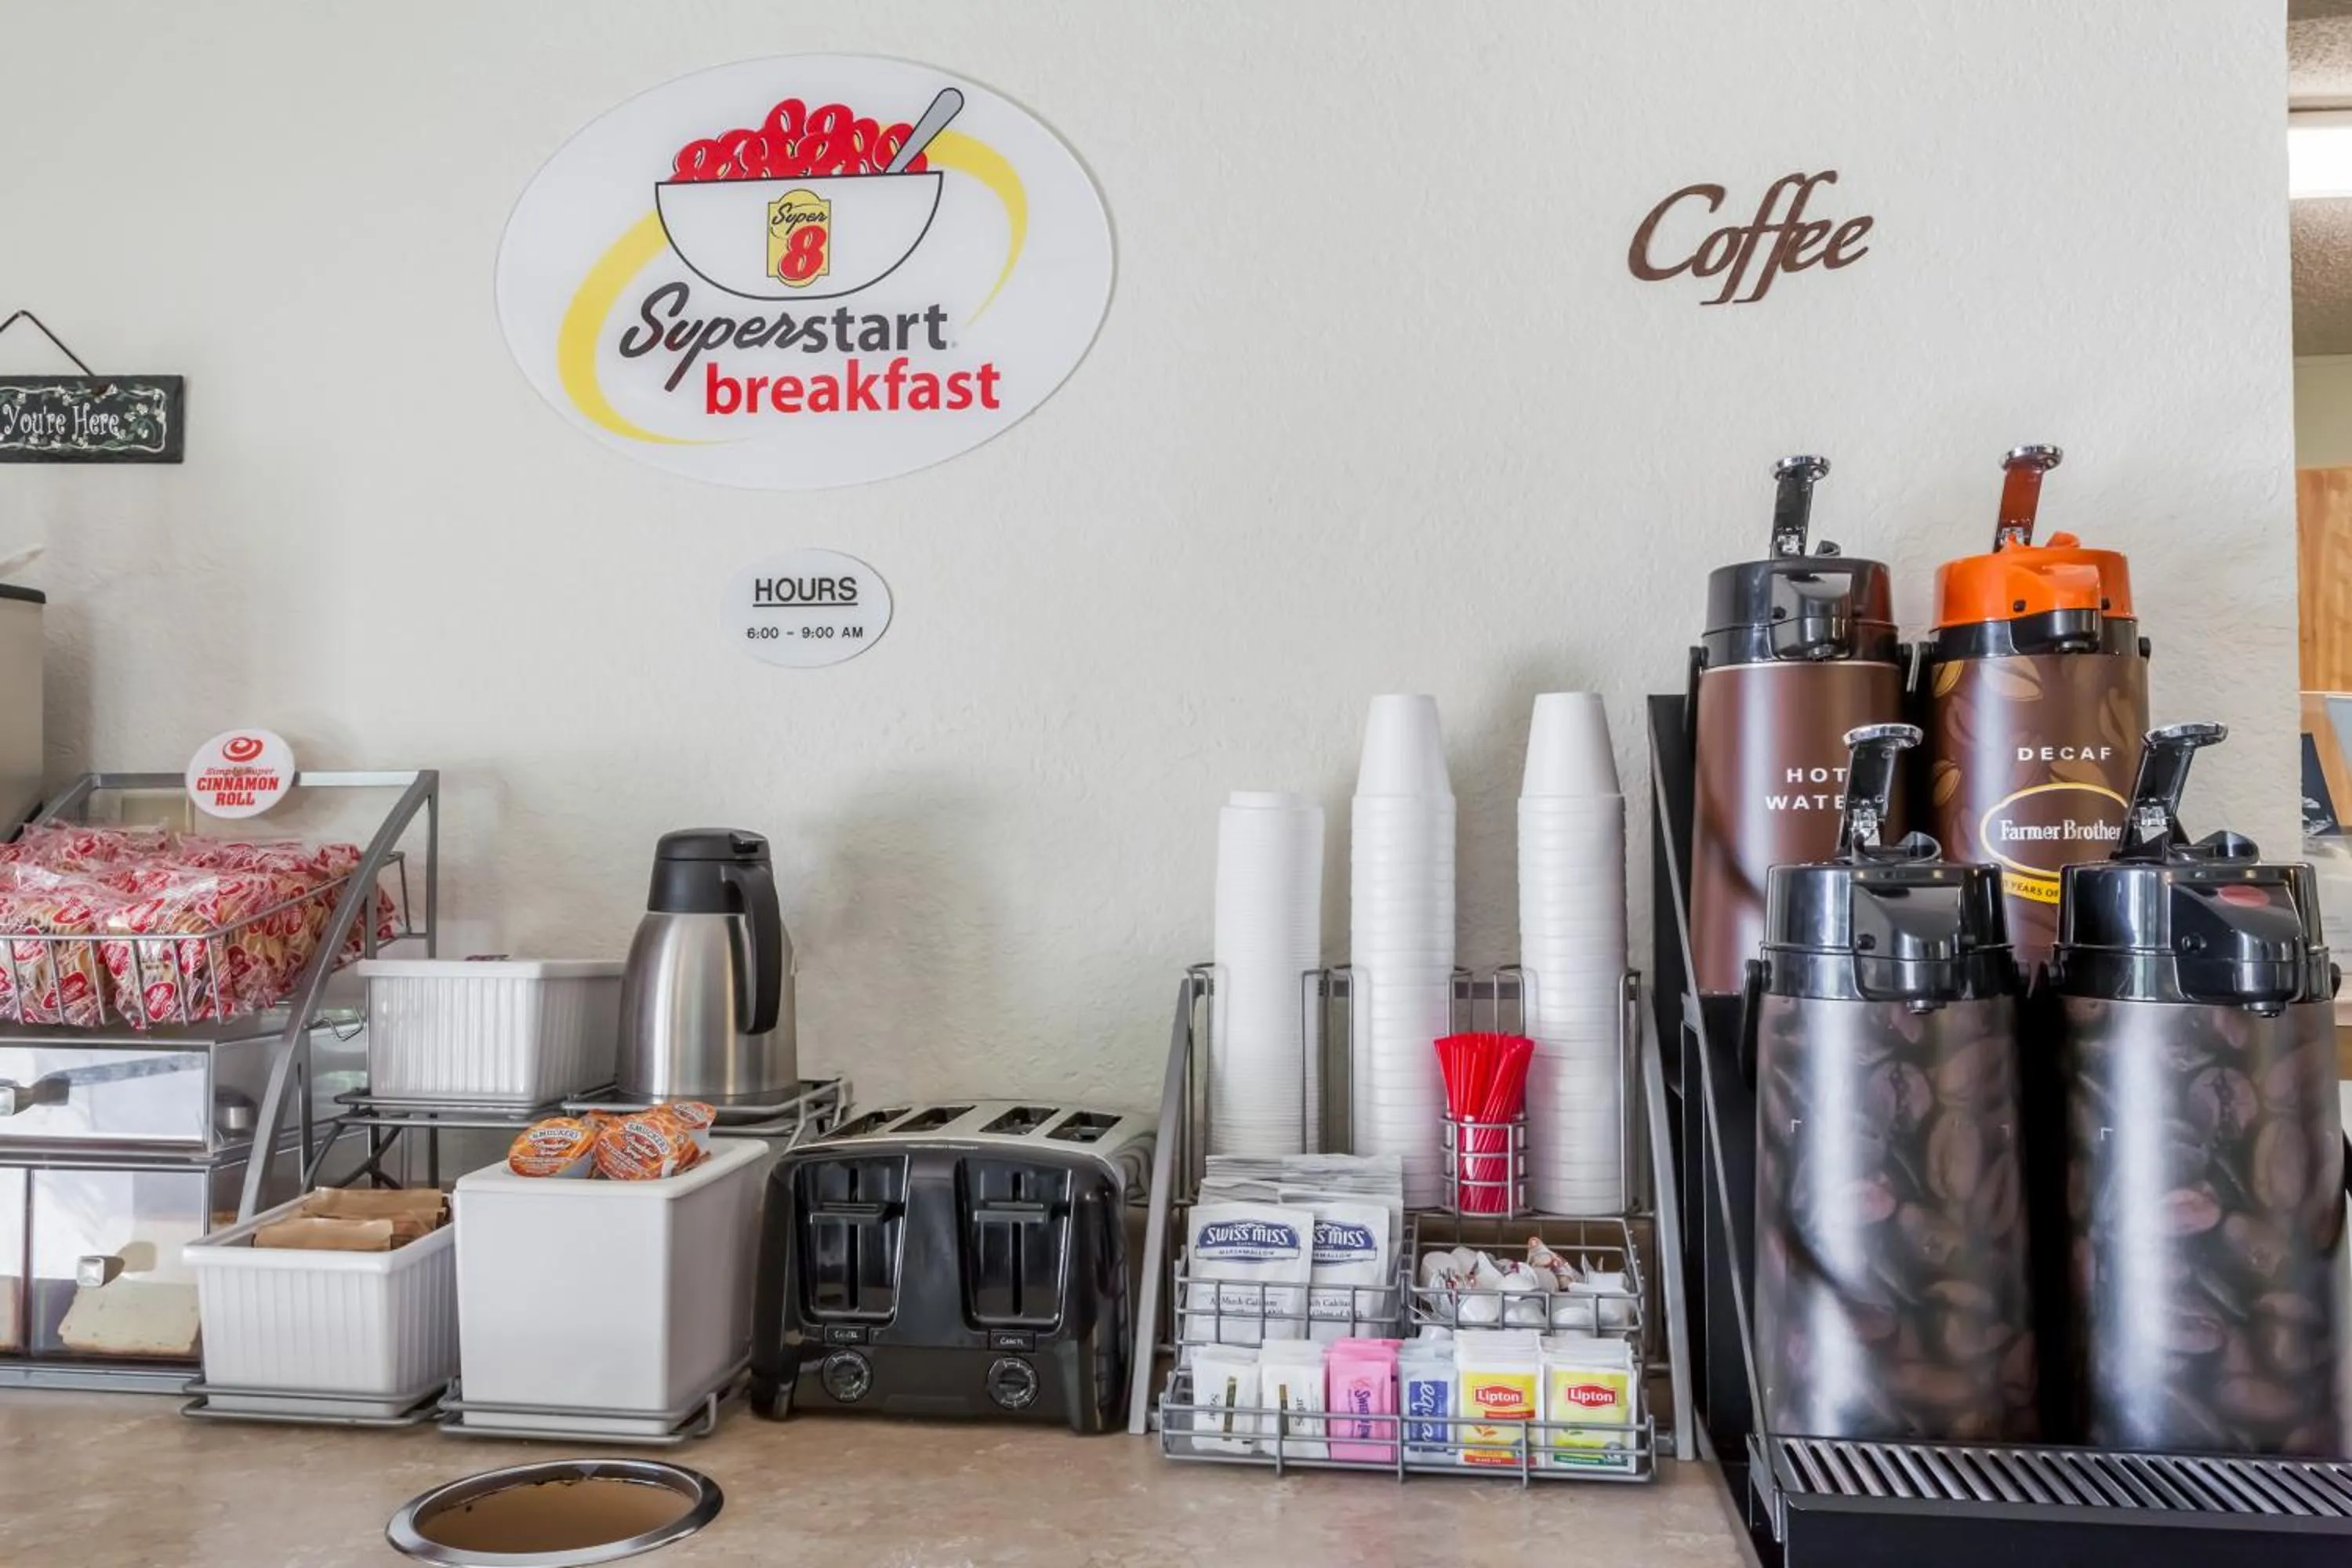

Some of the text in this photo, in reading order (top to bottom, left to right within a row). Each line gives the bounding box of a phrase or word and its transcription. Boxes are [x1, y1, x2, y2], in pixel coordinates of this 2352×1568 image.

[771, 202, 829, 234] Super
[1628, 169, 1874, 306] Coffee
[777, 224, 828, 281] 8
[619, 281, 949, 393] Superstart
[706, 357, 1001, 415] breakfast
[2, 402, 120, 441] You're Here
[754, 576, 858, 602] HOURS
[746, 627, 779, 639] 6:00
[802, 627, 835, 639] 9:00
[841, 626, 863, 638] AM
[2017, 746, 2112, 761] DECAF
[196, 776, 279, 792] CINNAMON
[1786, 768, 1848, 783] HOT
[215, 792, 256, 807] ROLL
[1765, 794, 1846, 811] WATE
[2000, 819, 2122, 840] Farmer Brother
[2011, 880, 2042, 896] YEARS
[1477, 1388, 1519, 1406] Lipton
[1570, 1388, 1613, 1407] Lipton
[1410, 1381, 1436, 1444] equa
